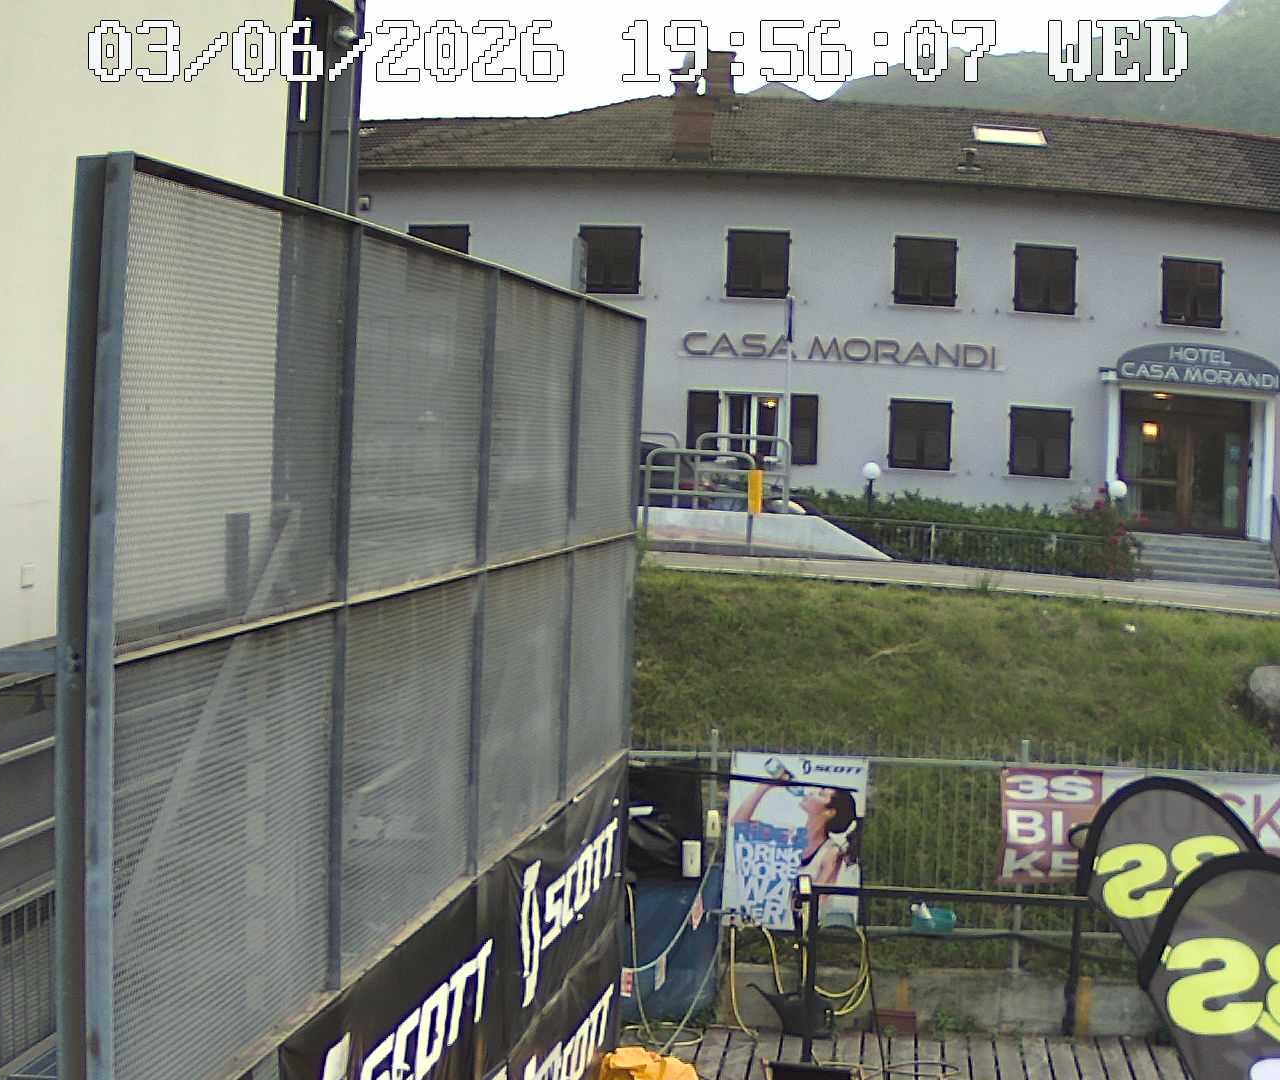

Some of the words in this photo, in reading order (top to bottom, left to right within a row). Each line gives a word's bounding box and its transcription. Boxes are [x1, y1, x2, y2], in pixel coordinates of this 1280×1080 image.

[682, 331, 797, 361] CASA
[808, 336, 997, 370] MORANDI
[1169, 346, 1232, 365] HOTEL
[1121, 362, 1179, 383] CASA
[1183, 368, 1280, 390] MORANDI
[815, 764, 864, 775] SCOTT
[1005, 774, 1095, 803] 3S
[736, 843, 803, 864] DRINK
[541, 816, 619, 951] SCOTT
